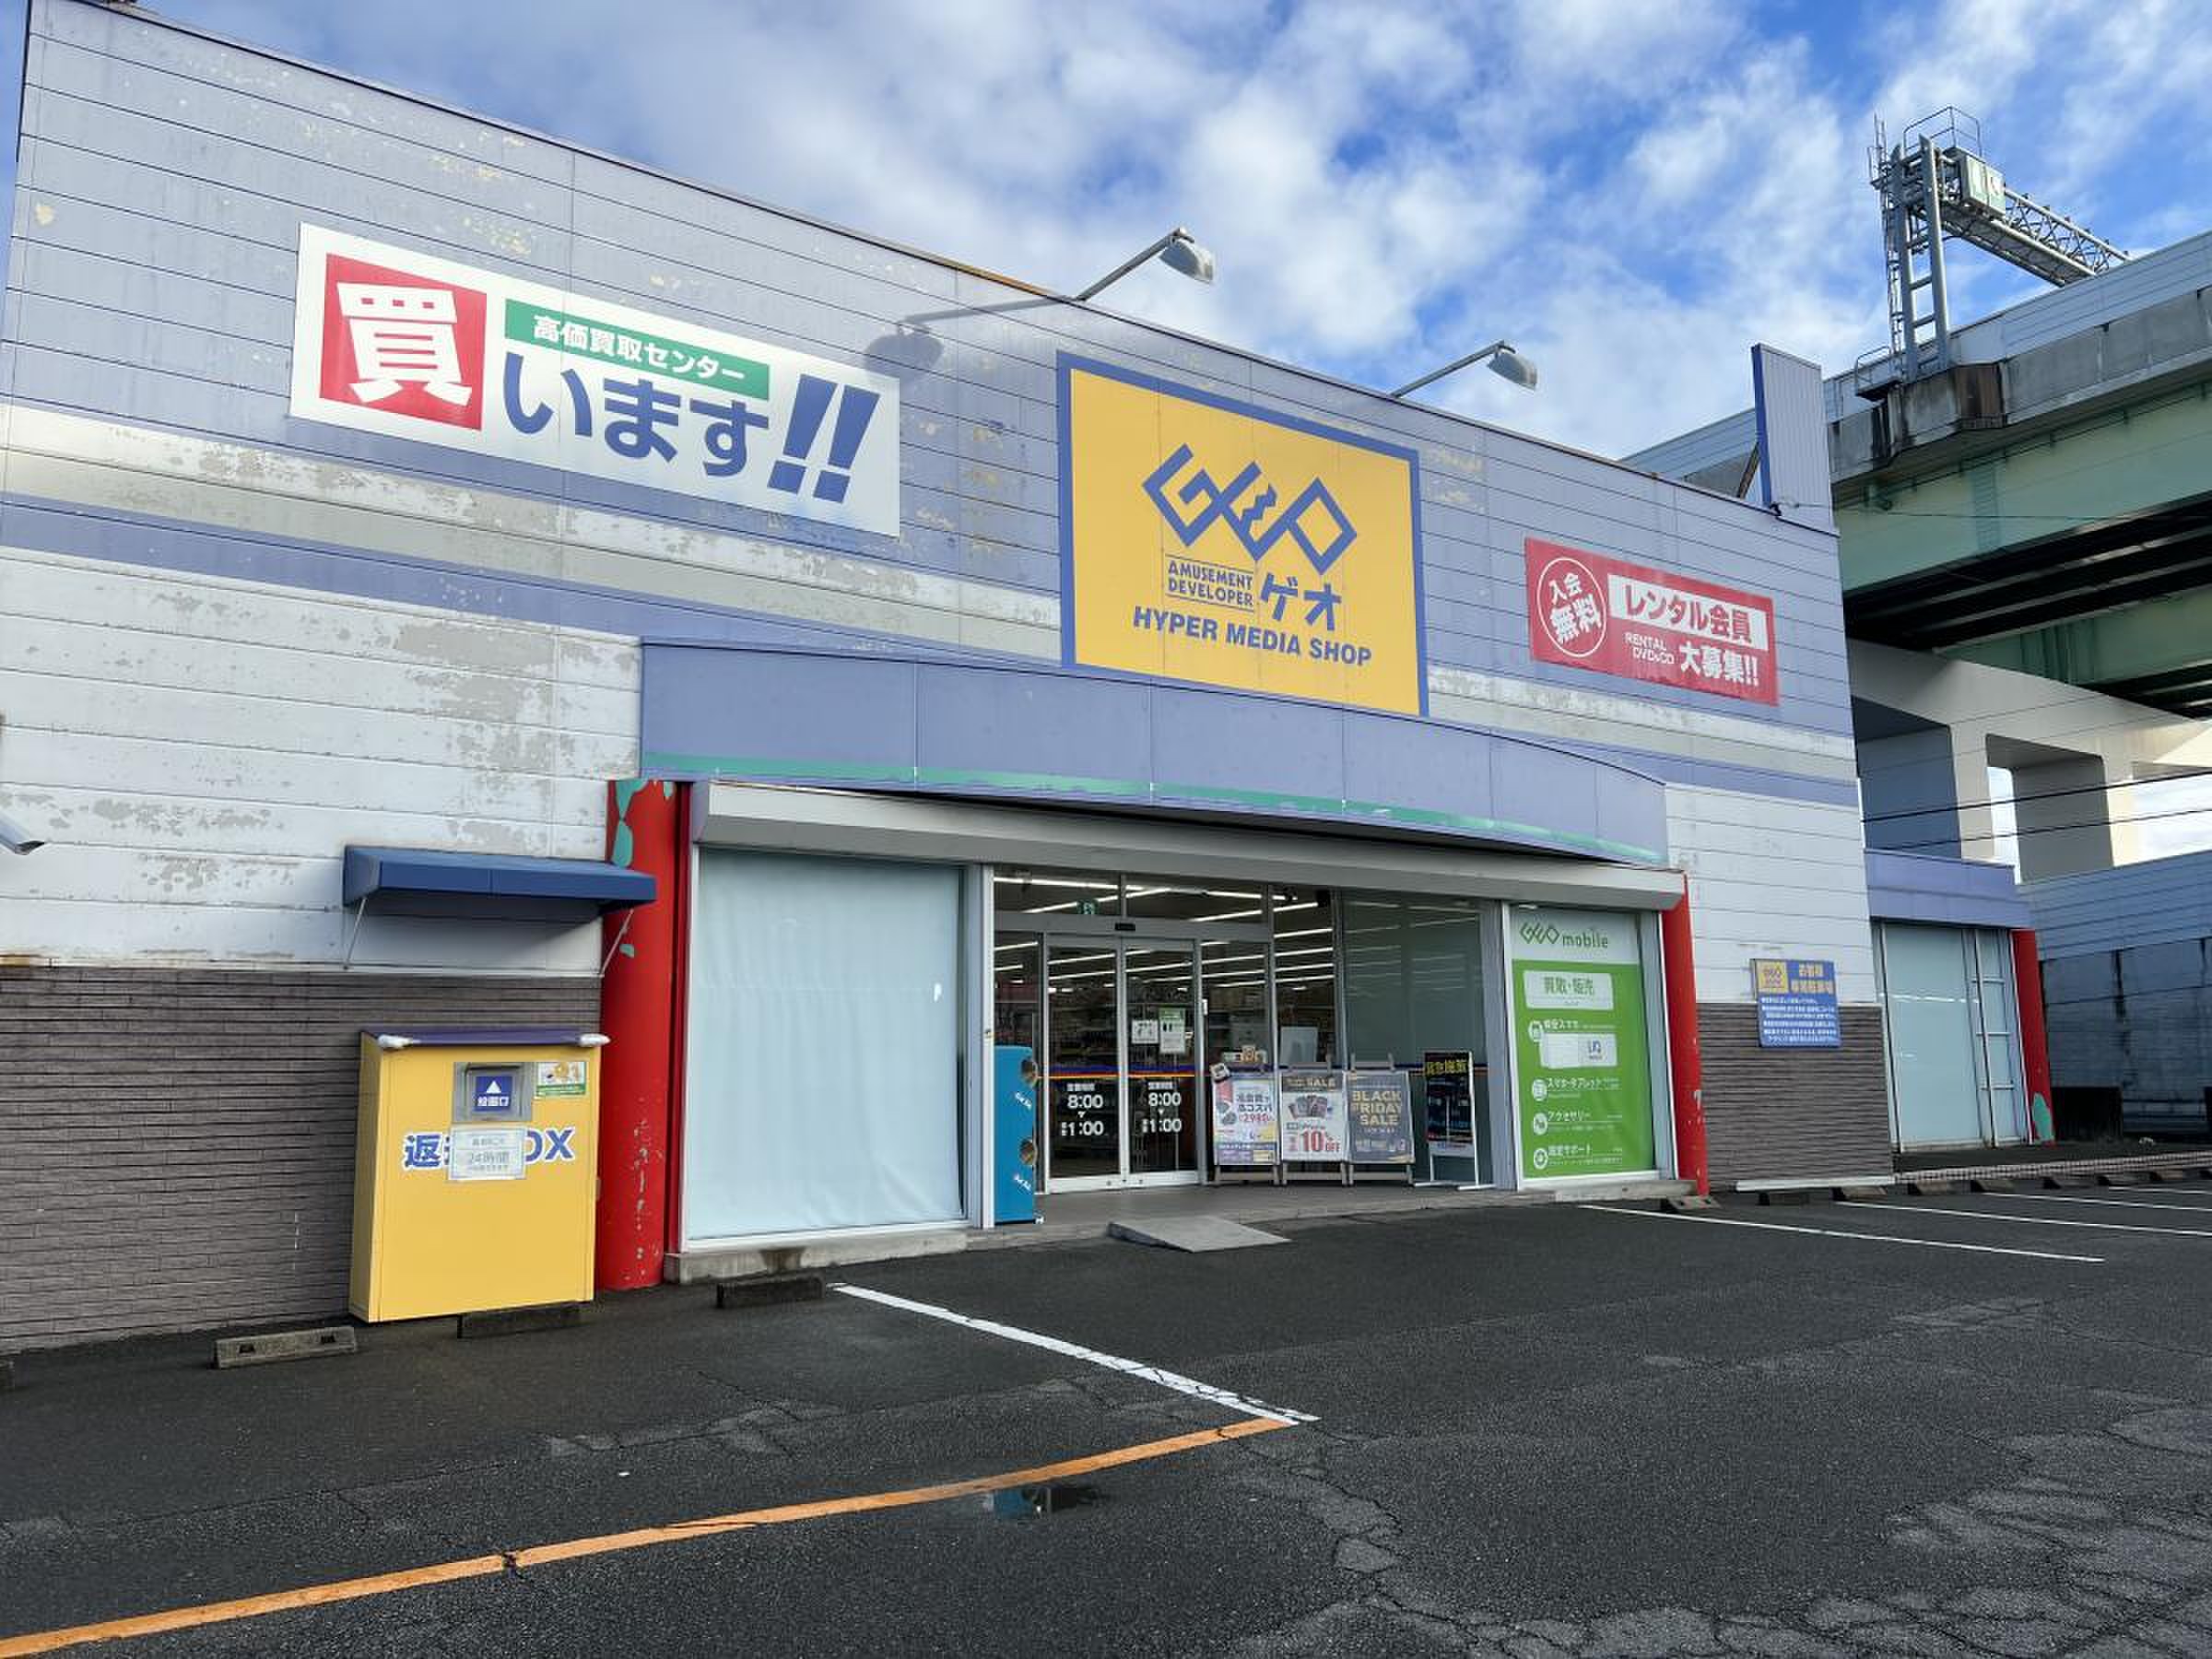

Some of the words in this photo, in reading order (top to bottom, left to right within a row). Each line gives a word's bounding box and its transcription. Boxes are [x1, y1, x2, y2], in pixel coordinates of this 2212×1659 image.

[533, 314, 746, 380] 高価買取センター
[1142, 443, 1358, 575] GEO
[1167, 560, 1253, 588] AMUSEMENT
[1548, 572, 1583, 604] 入会
[1167, 577, 1253, 607] DEVELOPER
[1260, 572, 1342, 631] ゲオ
[1549, 594, 1602, 644] 無料
[1624, 583, 1752, 647] レンタル会員
[1134, 606, 1218, 640] HYPER
[1226, 622, 1301, 655] MEDIA
[1309, 638, 1372, 667] SHOP
[1624, 632, 1667, 652] RENTAL
[1678, 641, 1759, 688] 大募集!!
[1561, 931, 1608, 949] mobile
[1067, 1094, 1104, 1109] 8:00
[1148, 1092, 1182, 1106] 8:00
[1350, 1101, 1403, 1114] FRIDAY
[1352, 1090, 1402, 1101] BLACK
[1359, 1113, 1400, 1125] SALE
